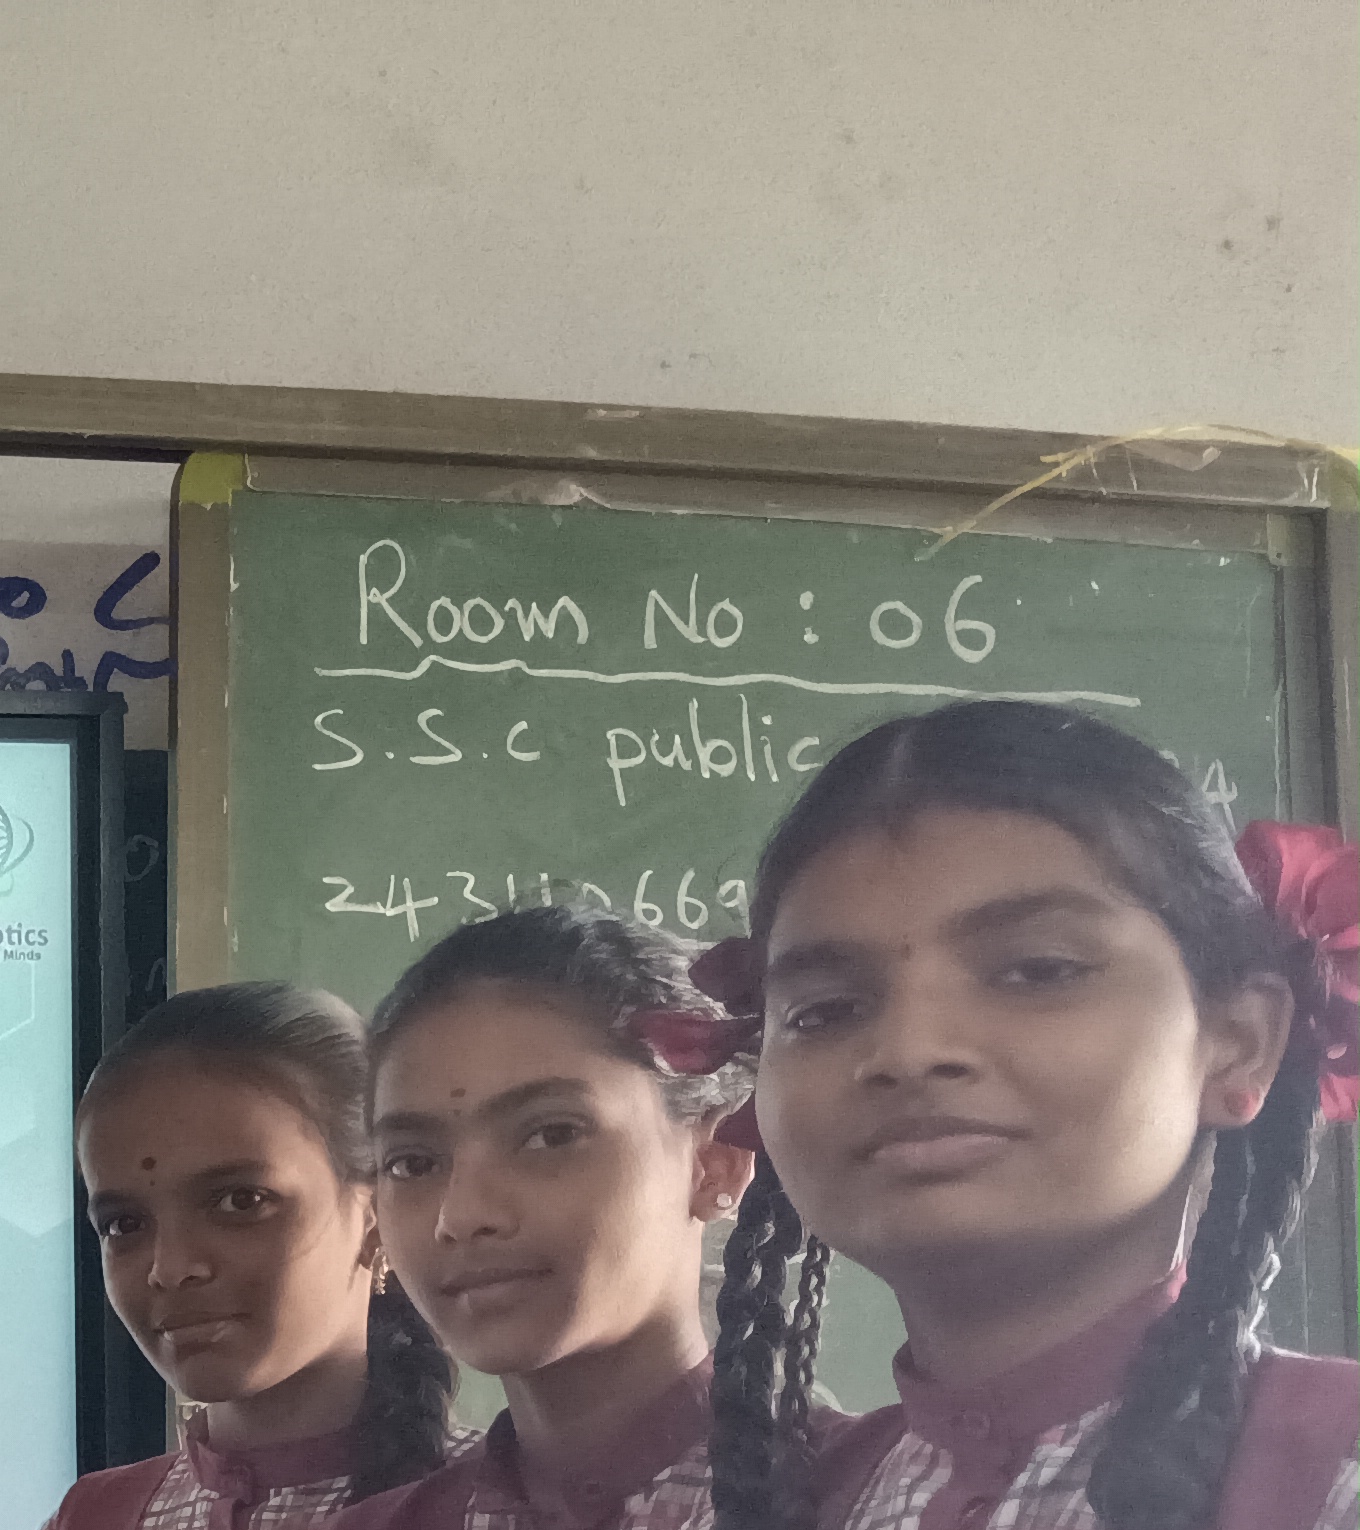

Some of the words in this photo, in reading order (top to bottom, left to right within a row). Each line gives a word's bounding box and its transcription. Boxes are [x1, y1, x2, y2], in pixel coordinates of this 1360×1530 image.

[358, 539, 590, 650] Room
[643, 573, 745, 650] No
[605, 694, 823, 806] public
[3, 948, 43, 962] Minds
